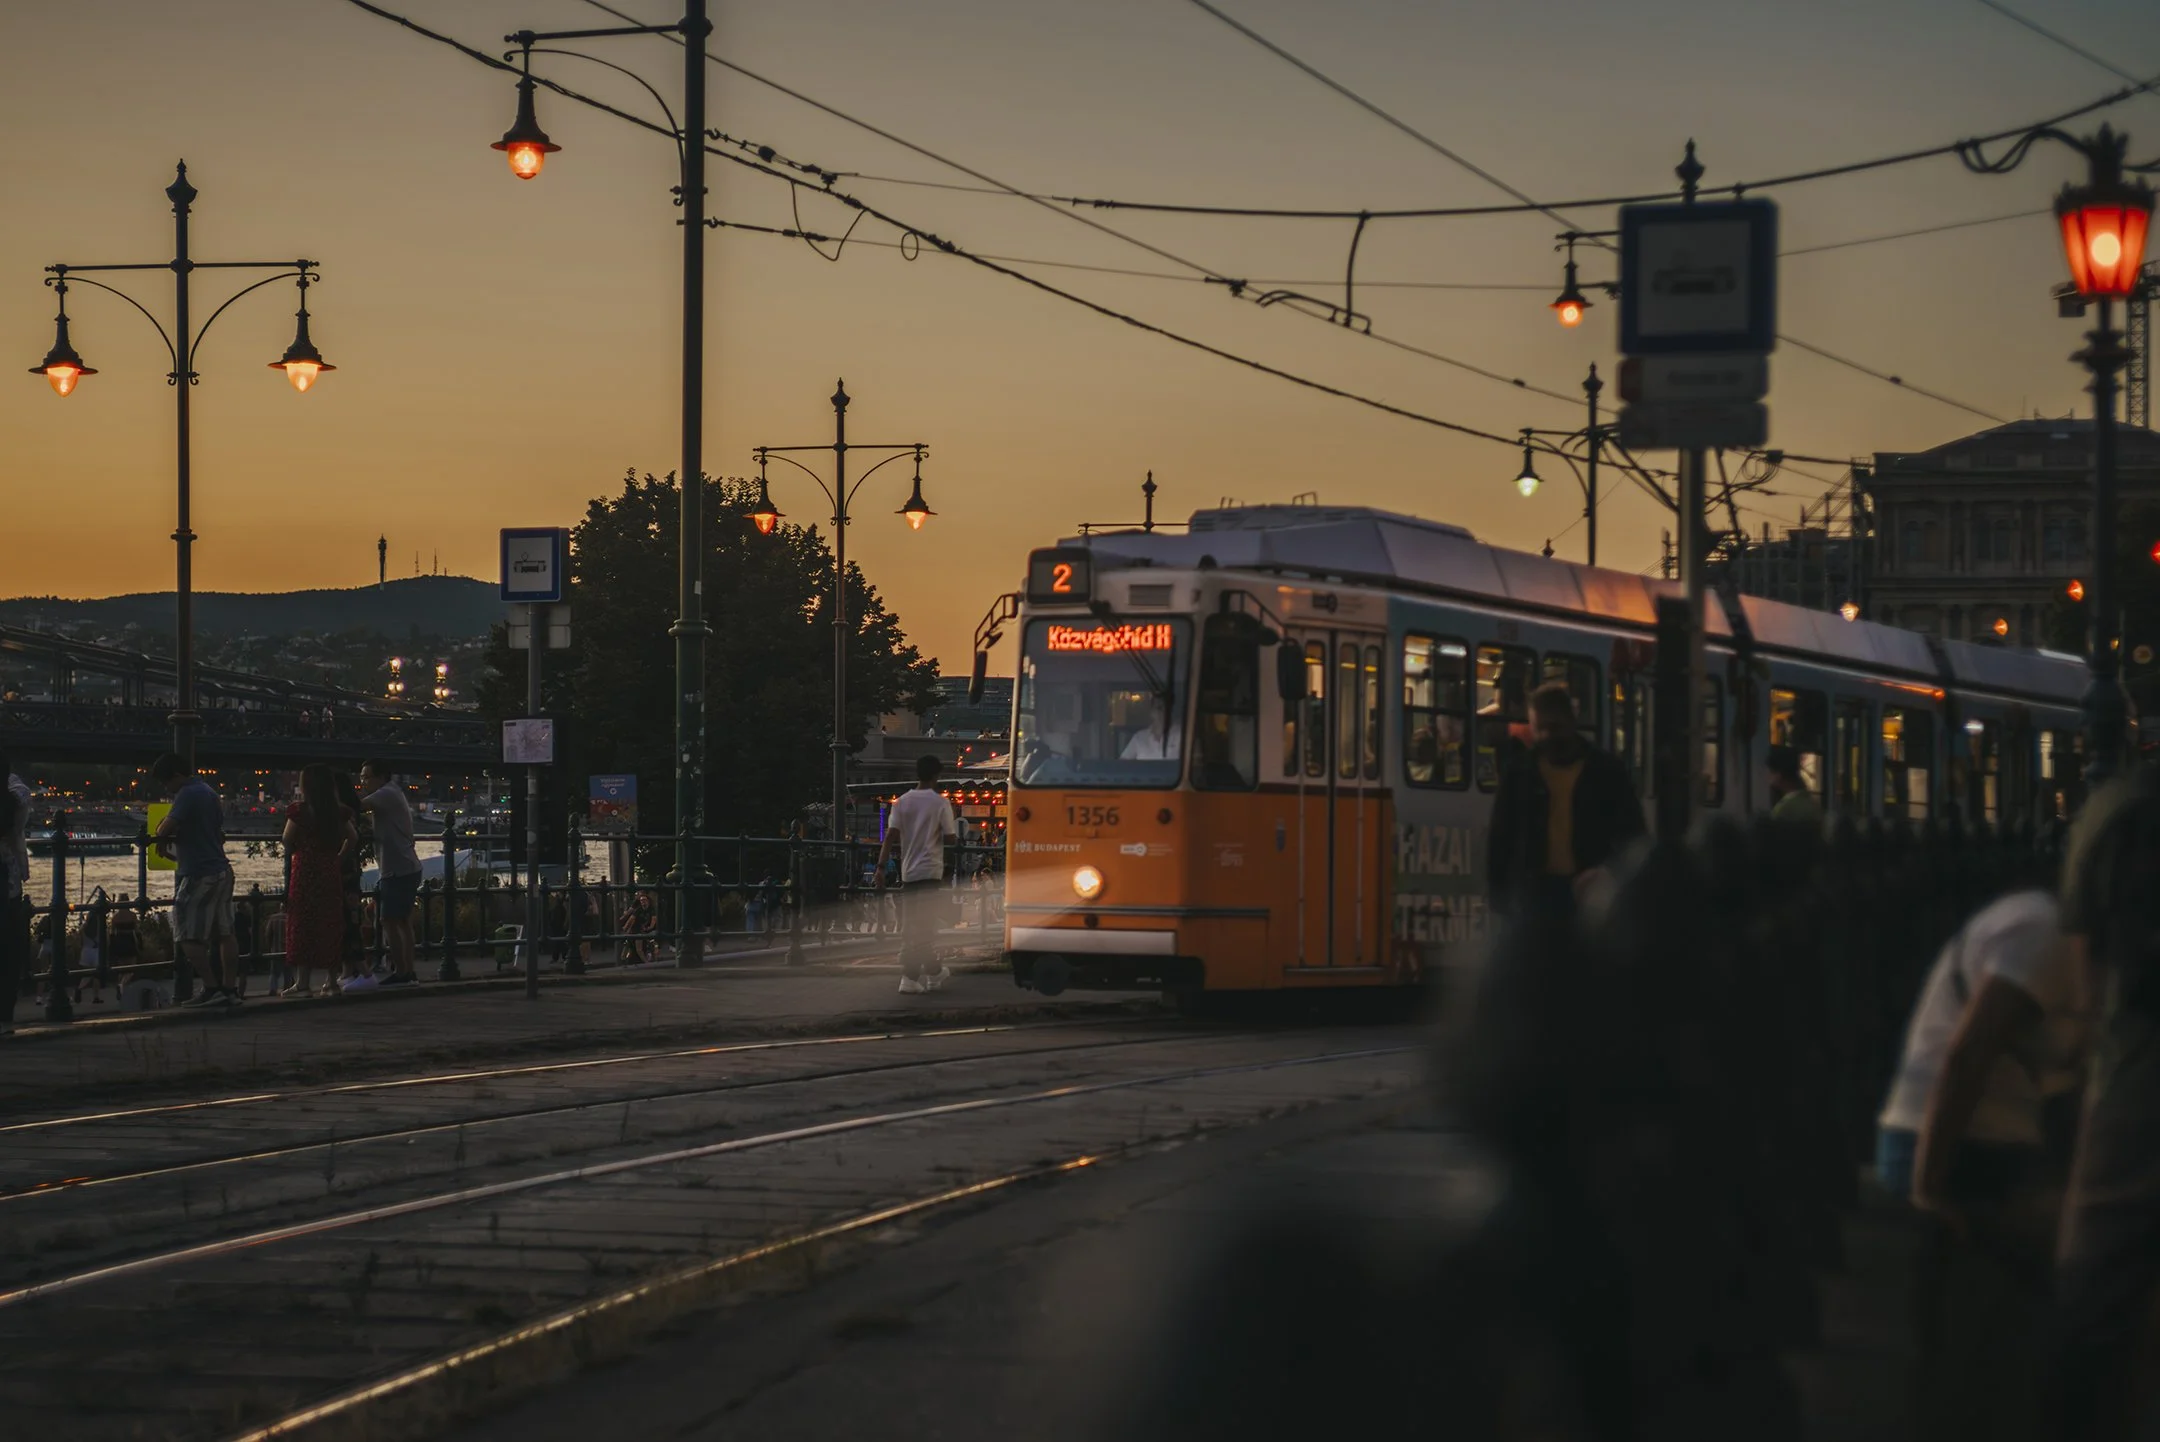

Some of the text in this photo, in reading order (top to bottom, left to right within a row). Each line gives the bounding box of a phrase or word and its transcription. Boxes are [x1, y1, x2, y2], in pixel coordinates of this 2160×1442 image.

[1053, 563, 1072, 593] 2
[1156, 624, 1171, 650] H
[1067, 805, 1119, 826] 1356
[1034, 843, 1081, 852] BUDAPEST
